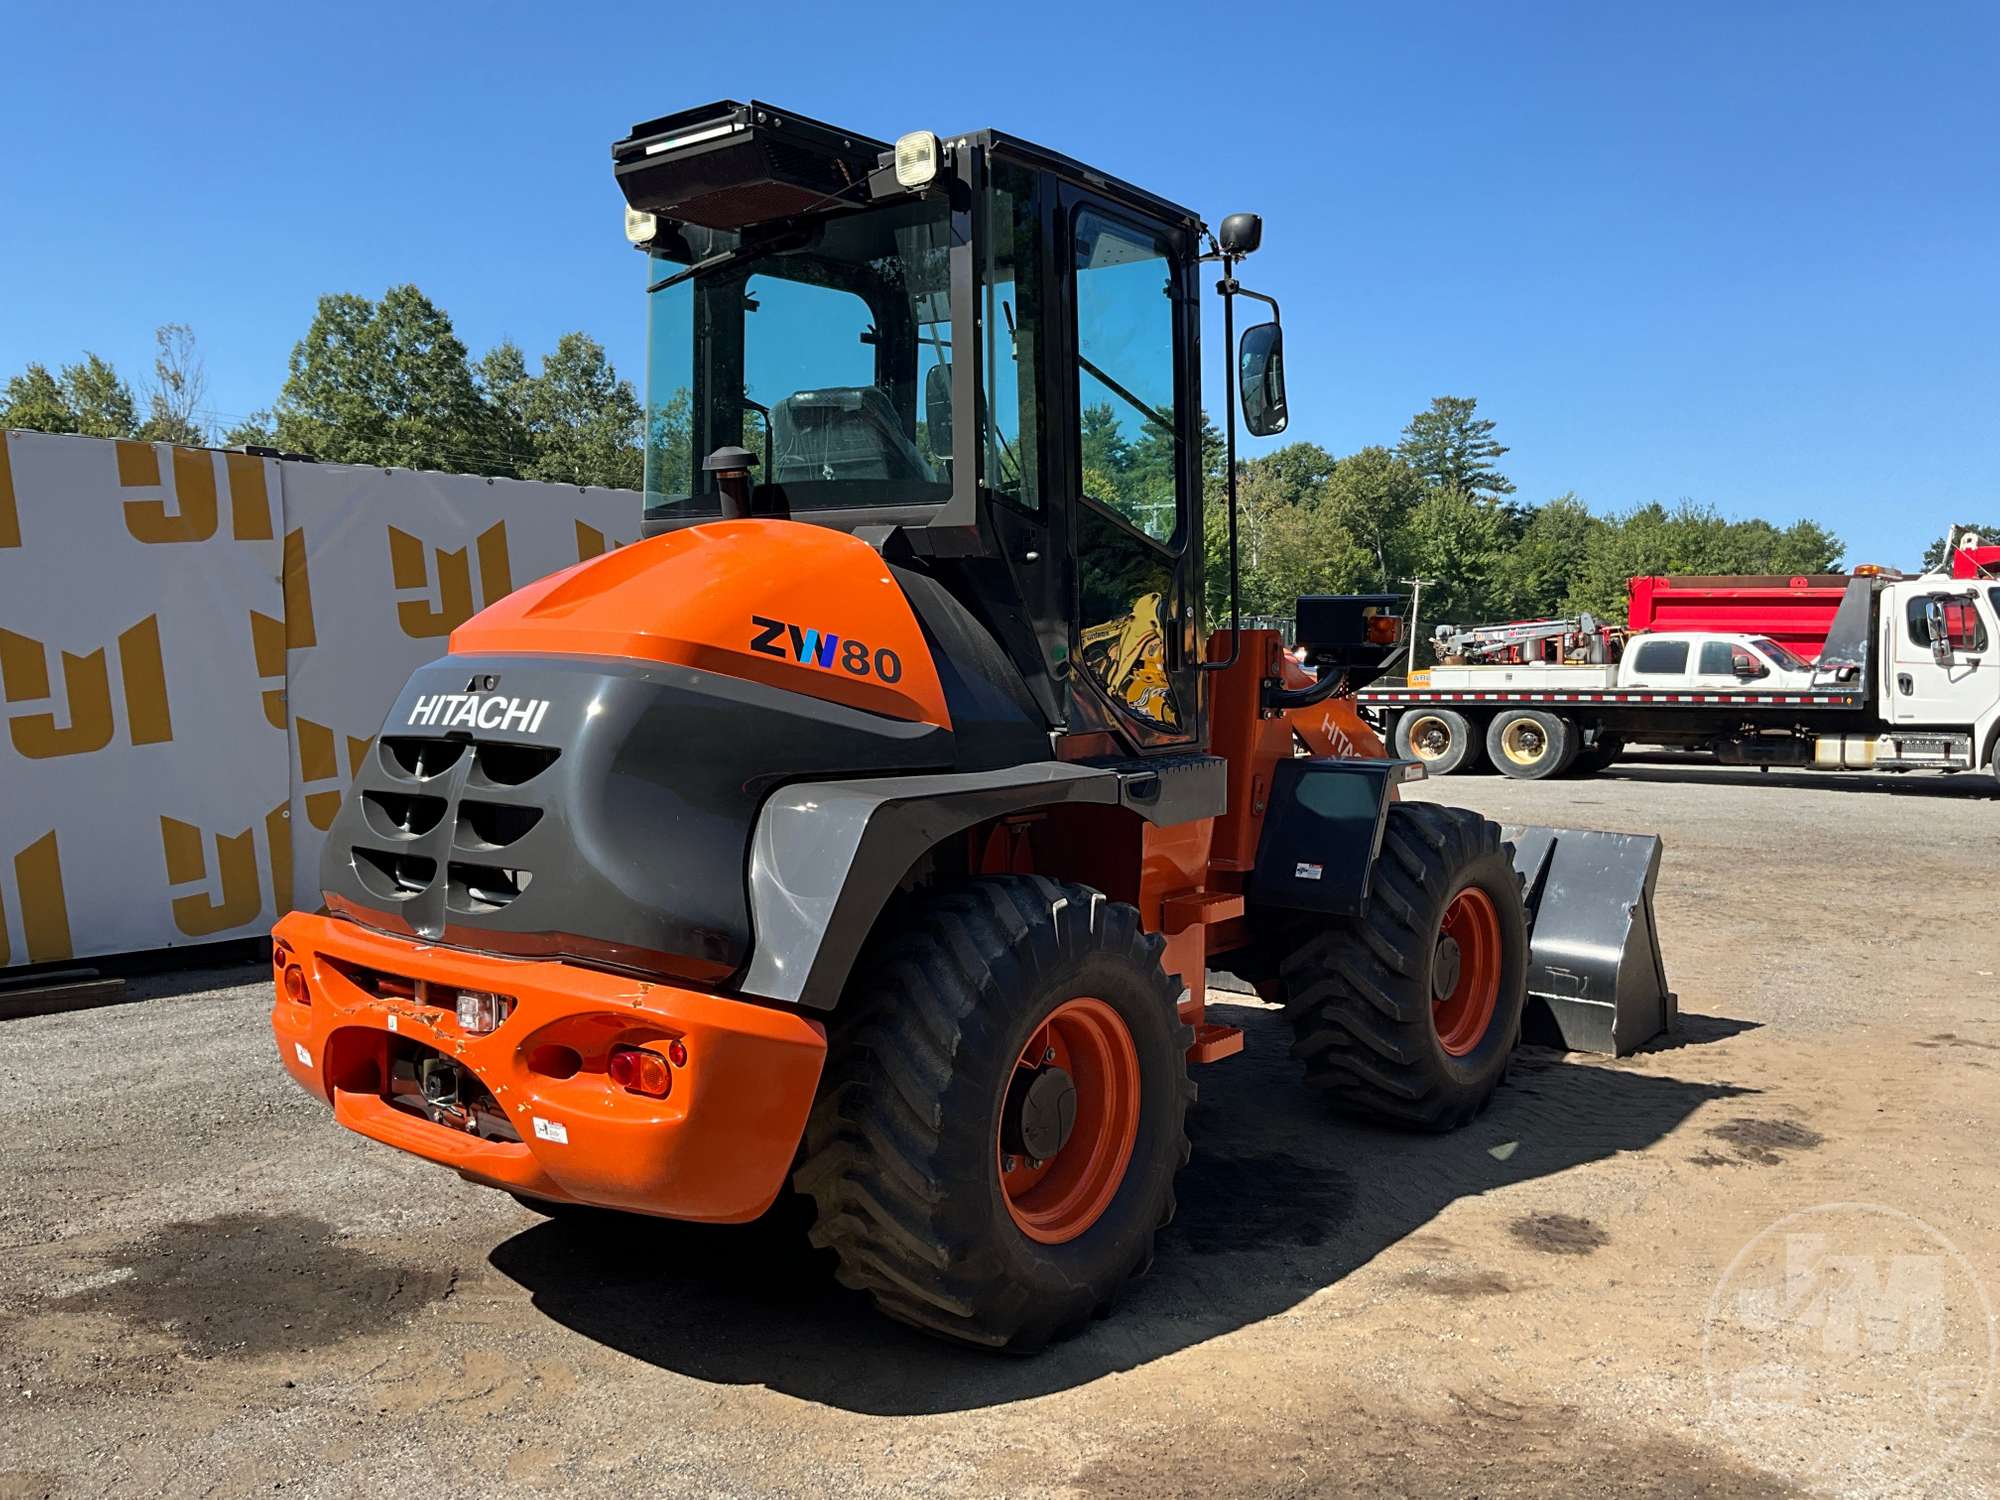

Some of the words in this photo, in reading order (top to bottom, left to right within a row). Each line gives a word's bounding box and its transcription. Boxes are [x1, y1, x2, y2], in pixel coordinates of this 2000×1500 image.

[750, 615, 902, 684] ZW80
[408, 695, 550, 733] HITACHI
[1321, 712, 1362, 757] HITA
